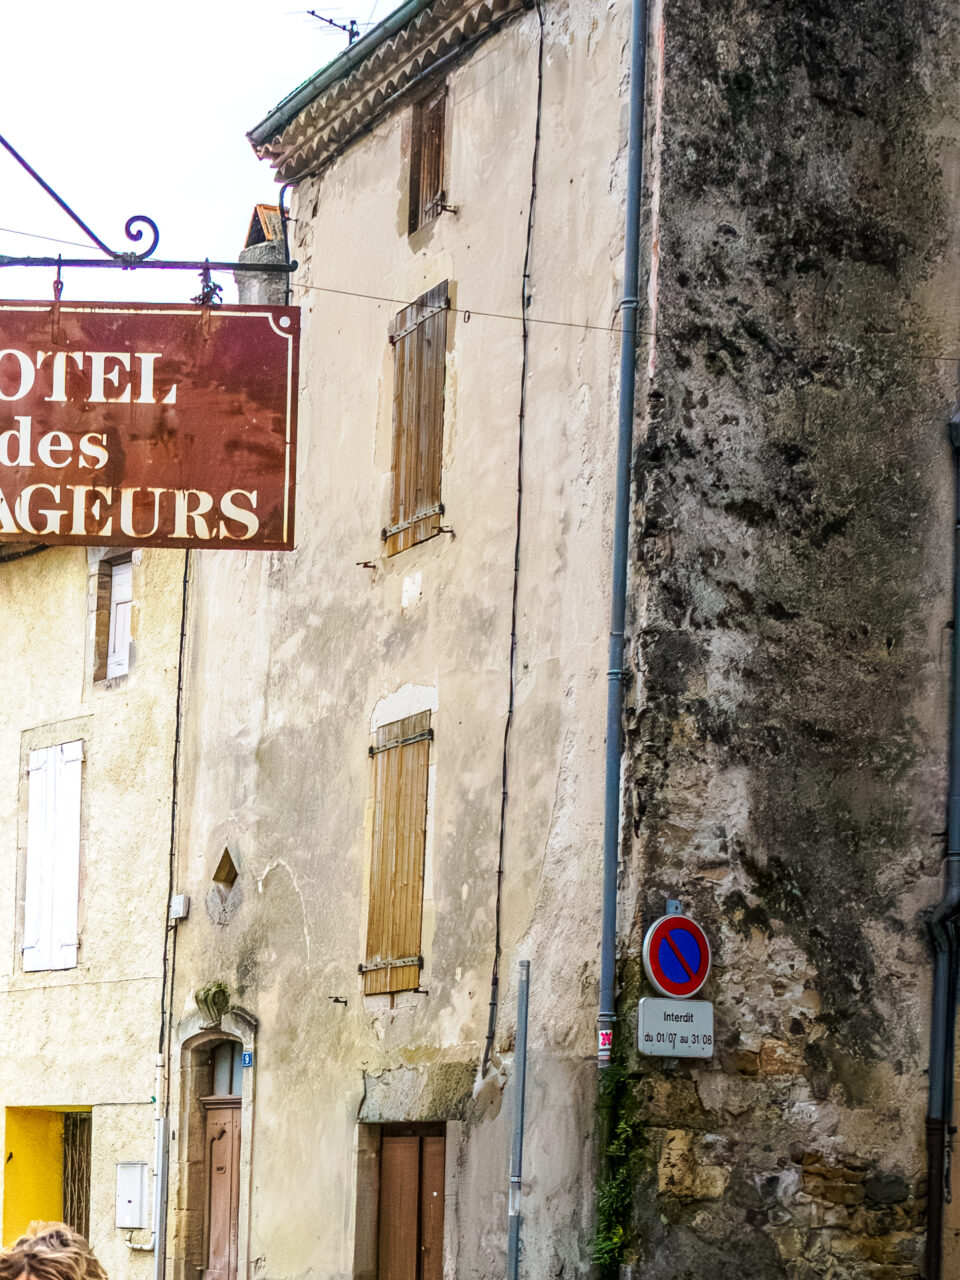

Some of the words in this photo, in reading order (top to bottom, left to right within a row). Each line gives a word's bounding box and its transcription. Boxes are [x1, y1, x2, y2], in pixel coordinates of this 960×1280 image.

[663, 1011, 694, 1023] Interdit
[644, 1032, 654, 1043] du
[680, 1035, 689, 1044] au
